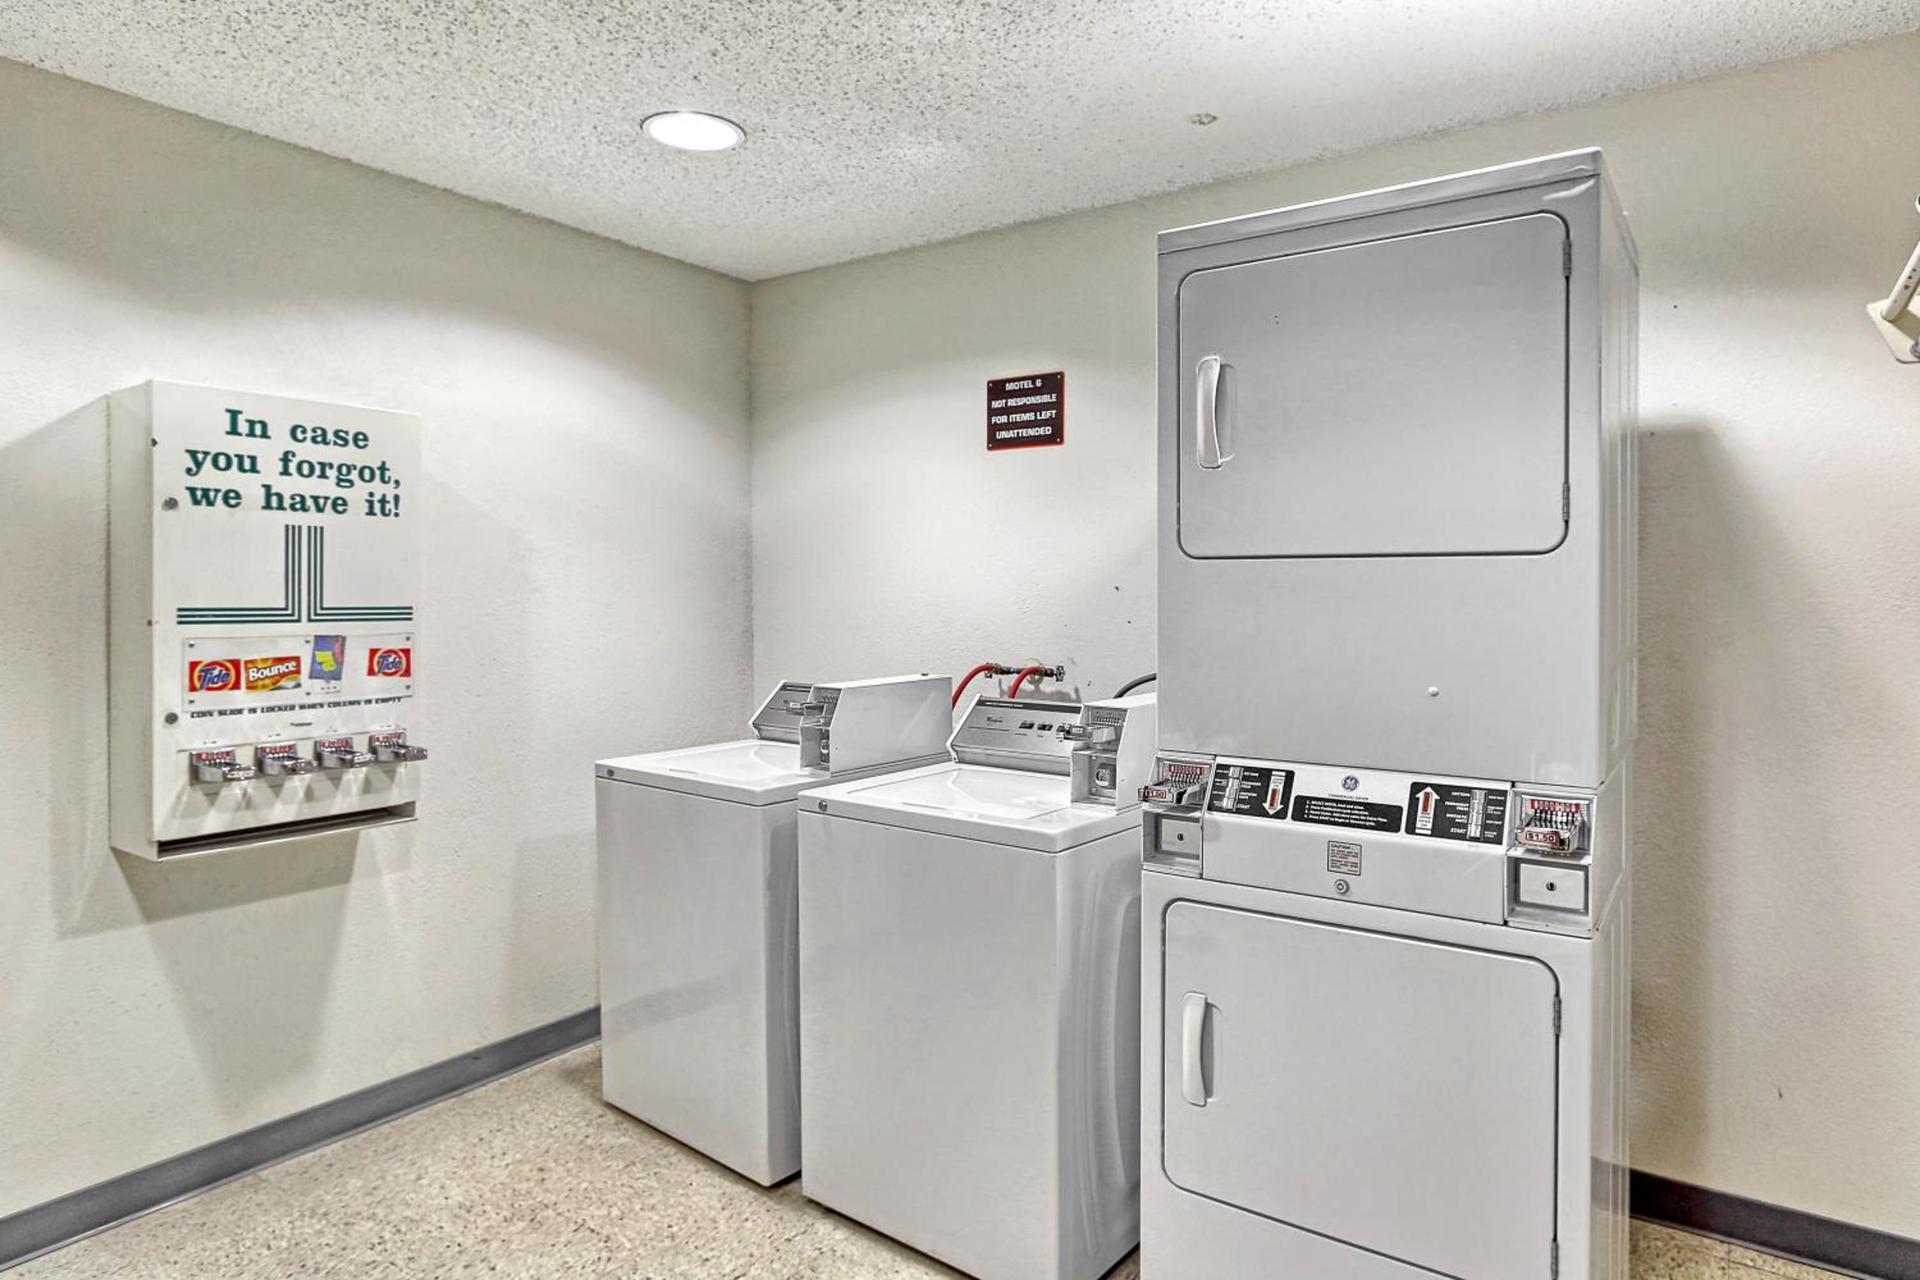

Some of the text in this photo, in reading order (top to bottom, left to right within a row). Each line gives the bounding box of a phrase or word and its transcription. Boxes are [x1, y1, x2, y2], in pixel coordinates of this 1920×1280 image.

[1005, 379, 1042, 391] MOTEL 6
[991, 393, 1057, 409] NOT RESPONSIBLE
[991, 410, 1057, 425] FOR ITEMS LEFT
[225, 408, 370, 449] In case
[995, 426, 1052, 439] UNATTENDED
[185, 448, 401, 489] you forgot,
[185, 484, 401, 518] we have it!
[249, 661, 297, 681] Bounce
[378, 654, 403, 673] Tide
[199, 666, 231, 690] Tide
